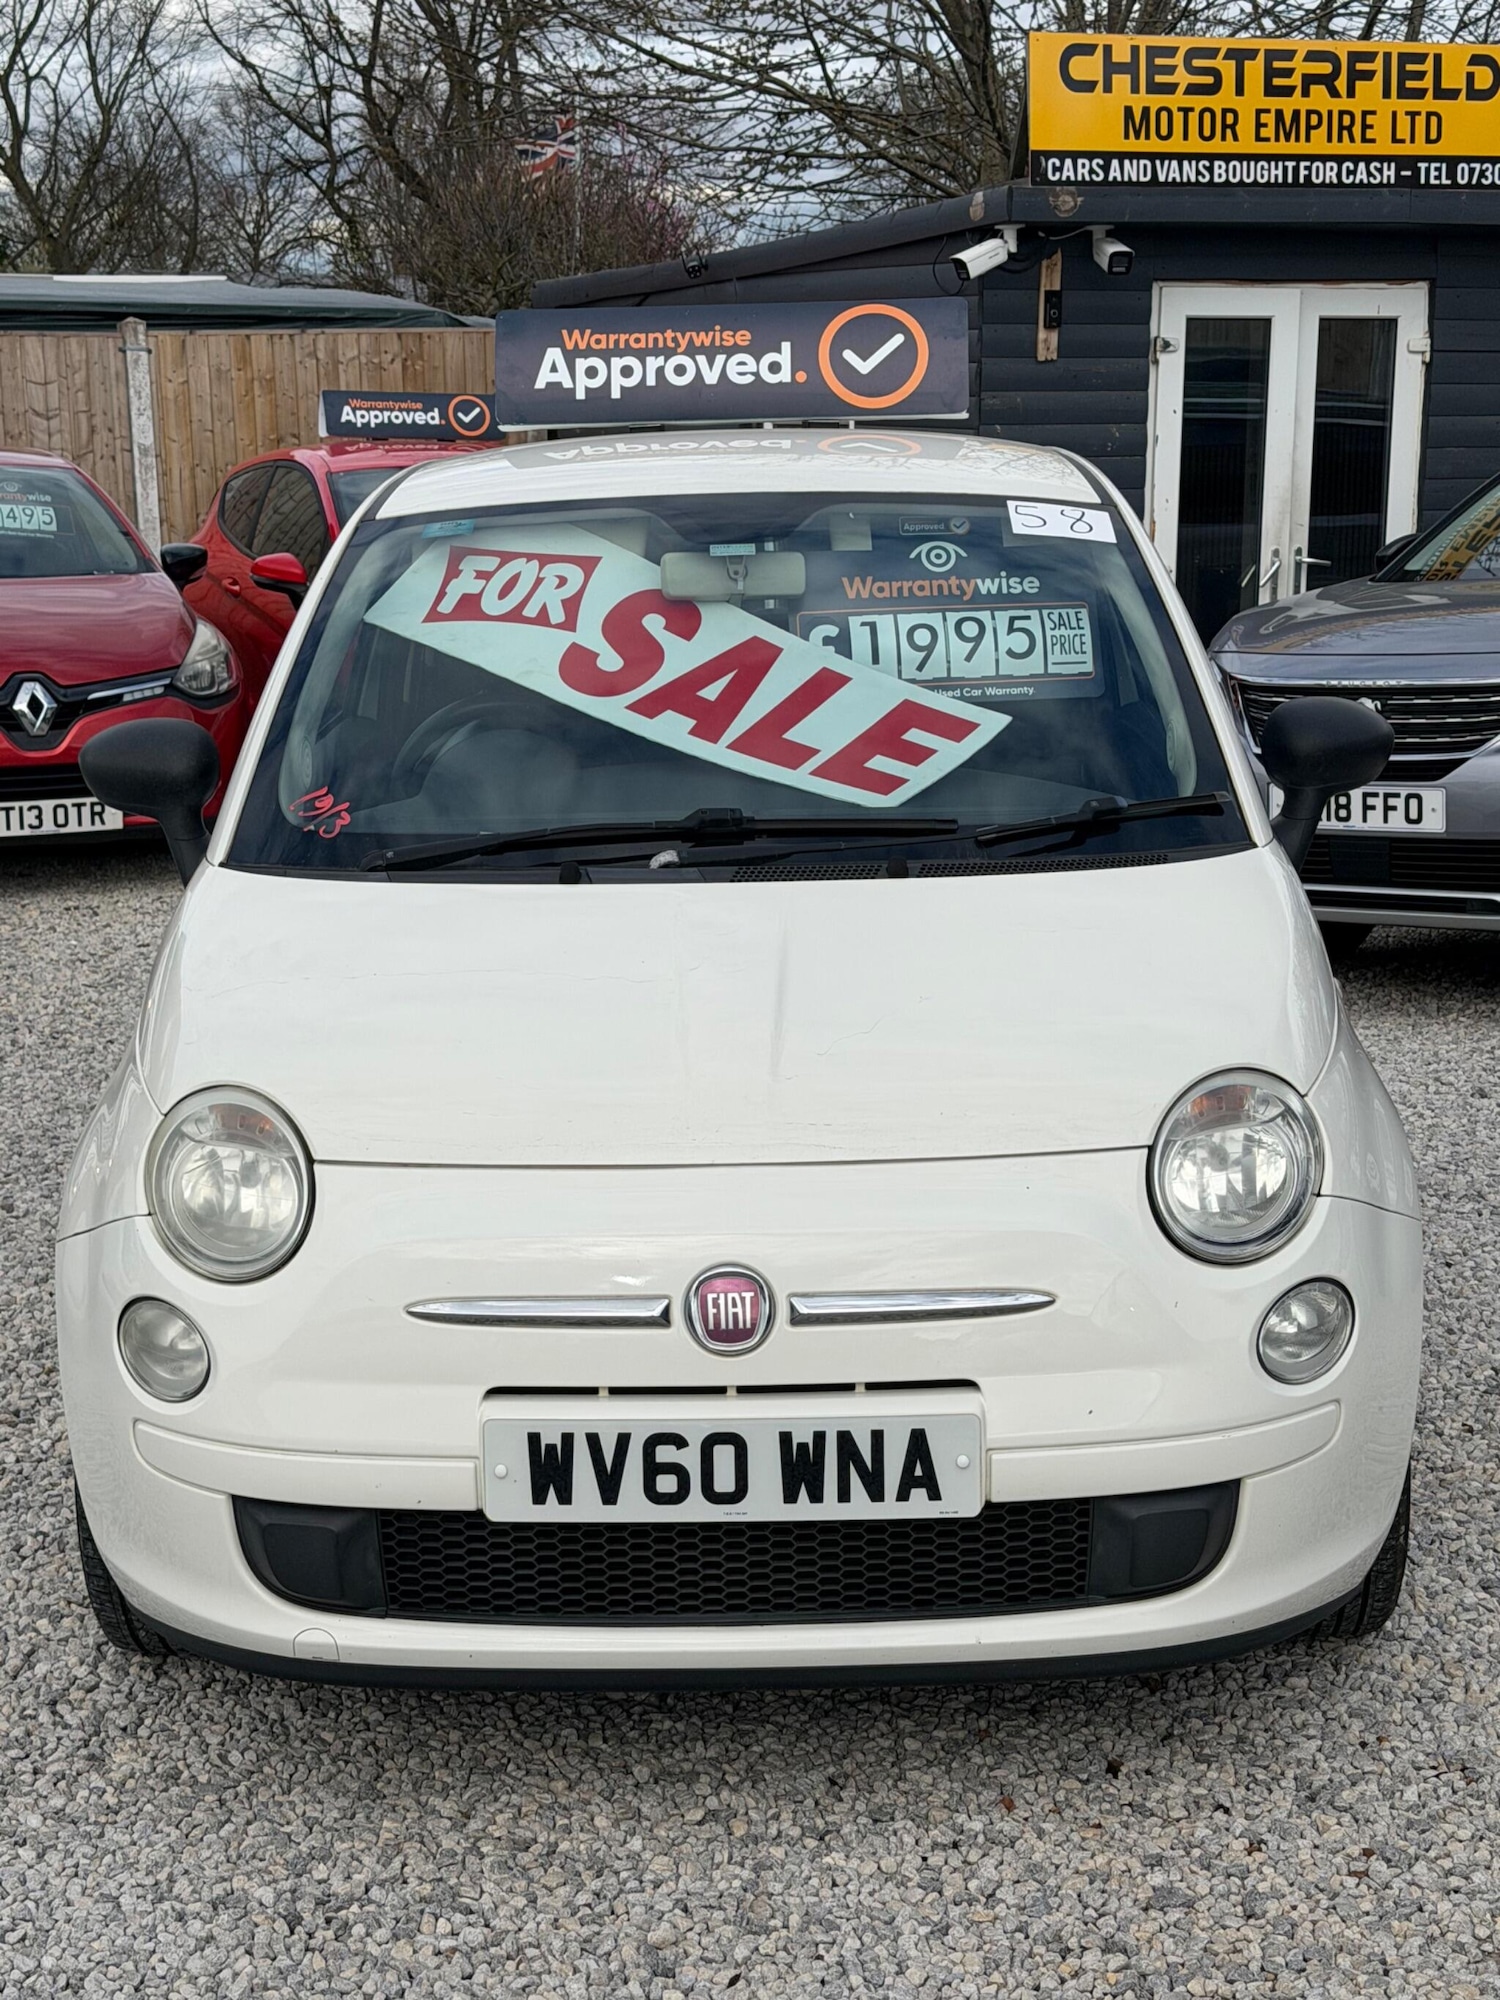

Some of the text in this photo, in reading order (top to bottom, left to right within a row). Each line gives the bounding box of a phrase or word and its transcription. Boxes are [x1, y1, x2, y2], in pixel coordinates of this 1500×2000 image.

[1059, 42, 1500, 102] CHESTERFIELD
[1123, 105, 1443, 145] MOTOR EMPIRE LTD
[1047, 157, 1104, 182] CARS
[1108, 158, 1151, 182] AND
[1155, 159, 1210, 183] VANS
[1213, 160, 1296, 184] BOUGHT
[1299, 161, 1338, 184] FOR
[1341, 162, 1396, 185] CASH
[1417, 162, 1451, 185] TEL
[561, 325, 752, 353] Warrantywise
[534, 341, 807, 400] Approved.
[340, 405, 446, 428] Approved.
[348, 398, 423, 410] Warrantywise
[903, 522, 945, 532] Approved
[841, 571, 1040, 601] Warrantywise
[1047, 611, 1085, 631] SALE
[1050, 633, 1087, 656] PRICE
[437, 555, 982, 797] FOR SALE
[963, 687, 982, 696] Car
[53, 801, 106, 828] OTR
[1320, 791, 1423, 825] 18 FFO
[707, 1291, 755, 1330] FIAT
[526, 1428, 942, 1506] WV60 WNA
